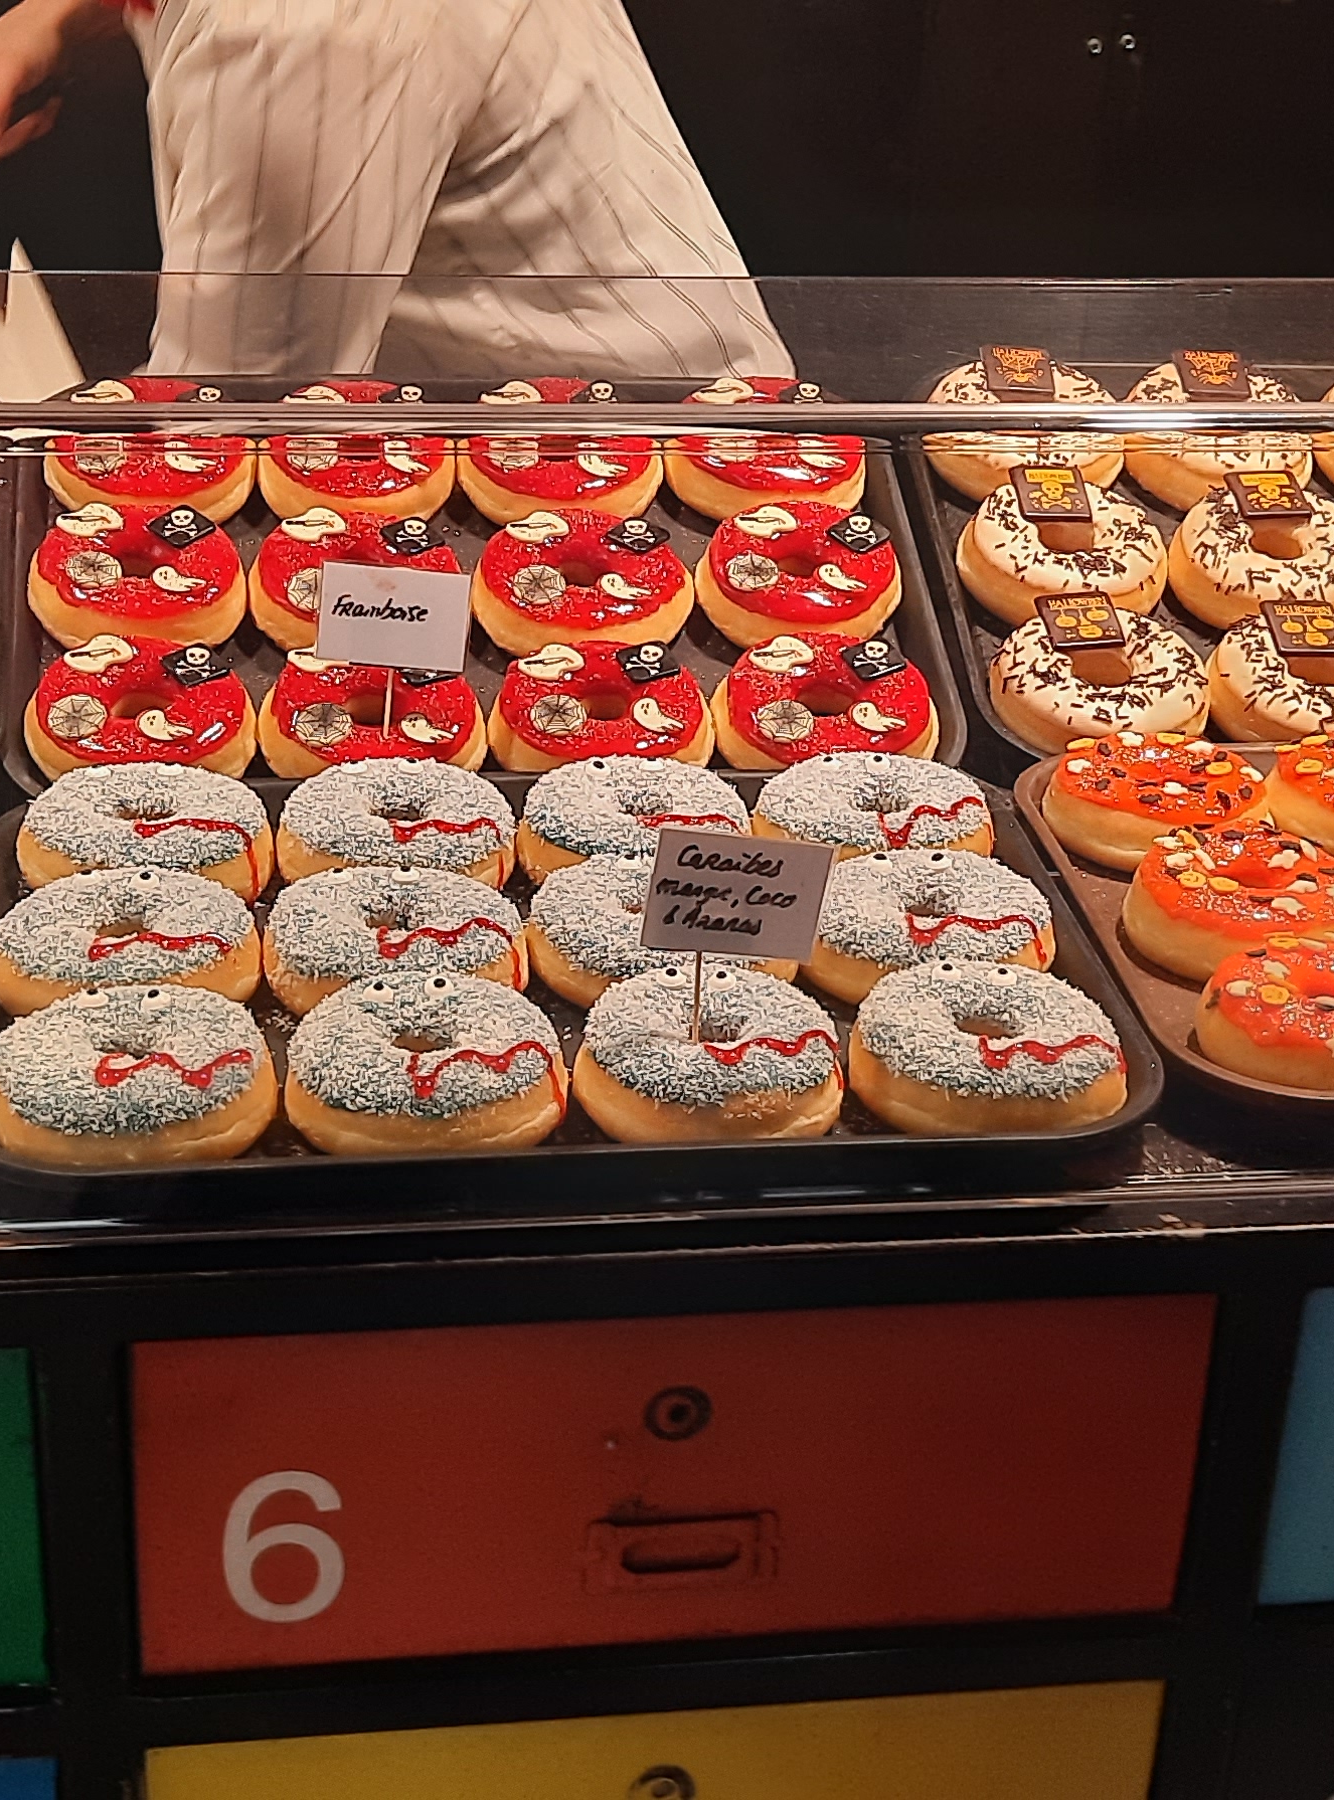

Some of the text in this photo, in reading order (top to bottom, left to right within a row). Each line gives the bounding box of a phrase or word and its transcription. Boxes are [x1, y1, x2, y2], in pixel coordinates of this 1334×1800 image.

[331, 594, 429, 622] Framboise
[746, 885, 797, 908] Coco
[682, 905, 762, 936] Ananas
[222, 1470, 345, 1623] 6
